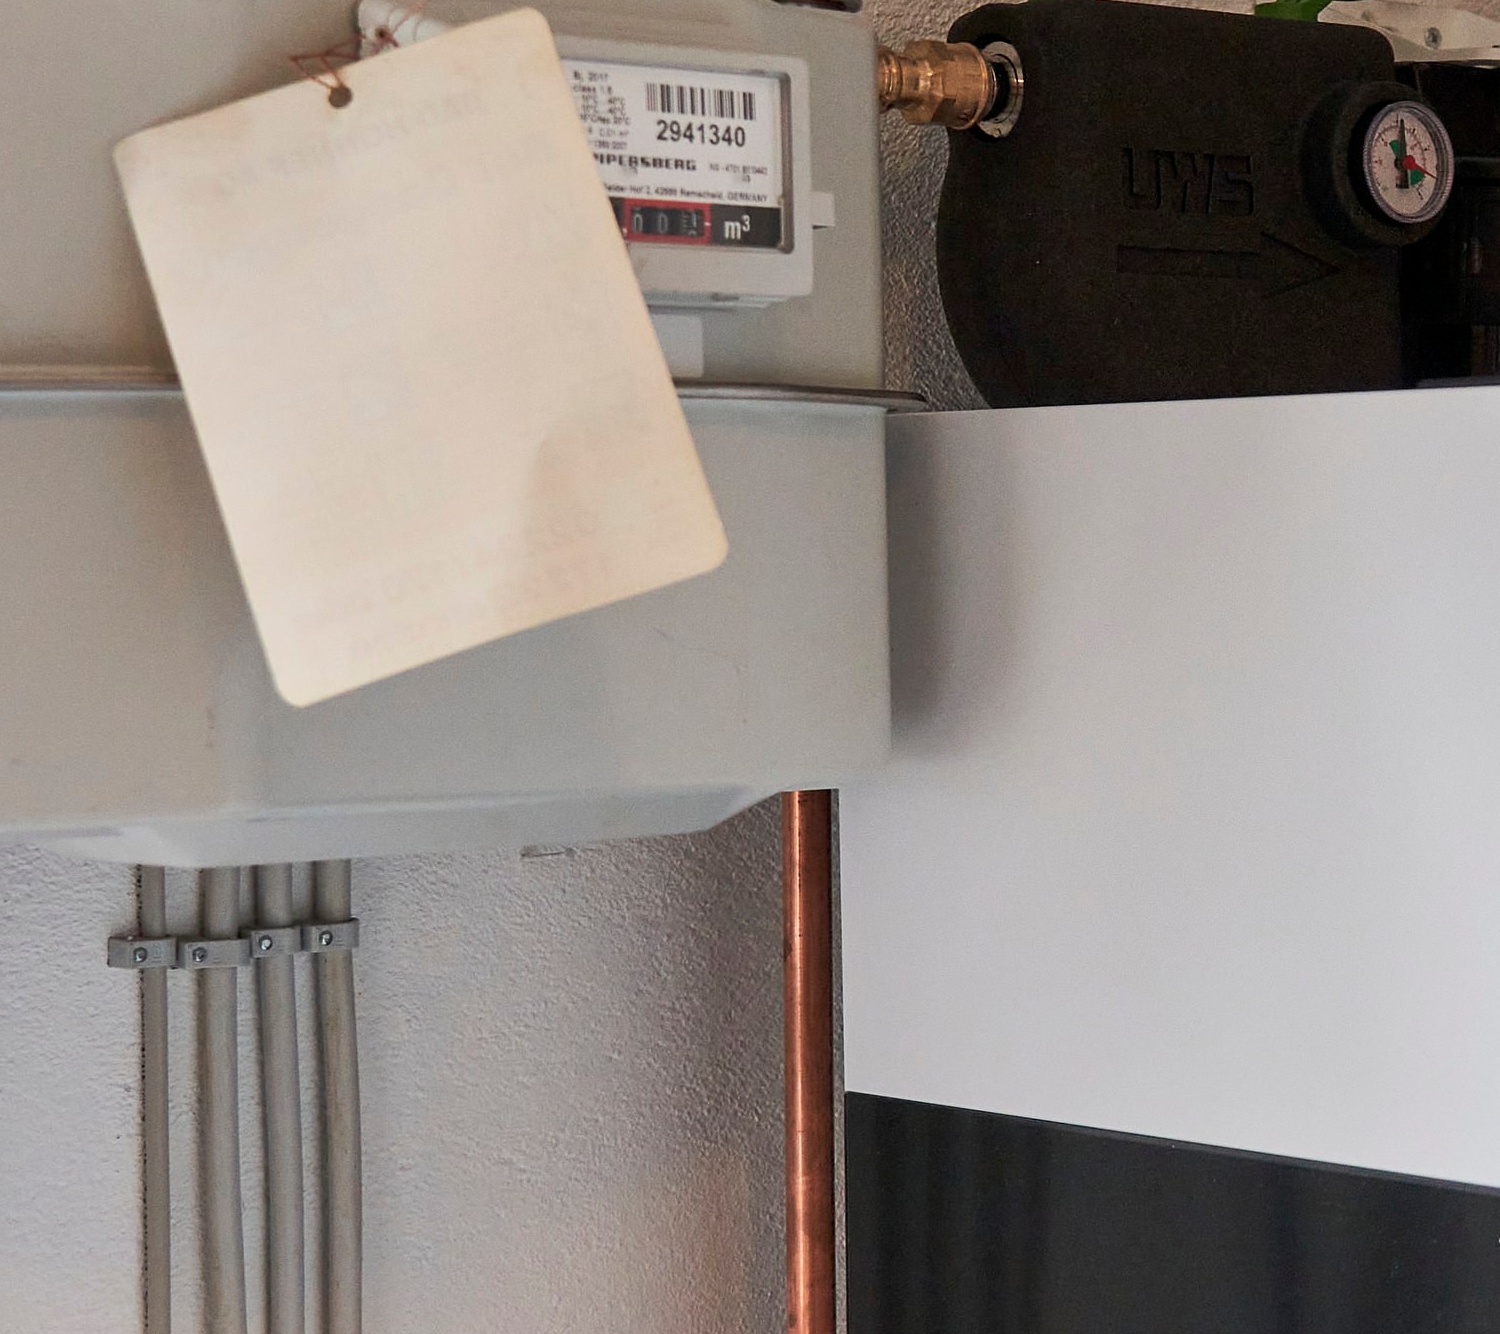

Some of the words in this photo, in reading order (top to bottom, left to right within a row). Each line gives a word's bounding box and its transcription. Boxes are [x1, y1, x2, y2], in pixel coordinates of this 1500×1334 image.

[657, 120, 746, 148] 2941340
[1122, 147, 1255, 216] UWS
[728, 192, 767, 203] GERMANY
[724, 214, 751, 240] m³
